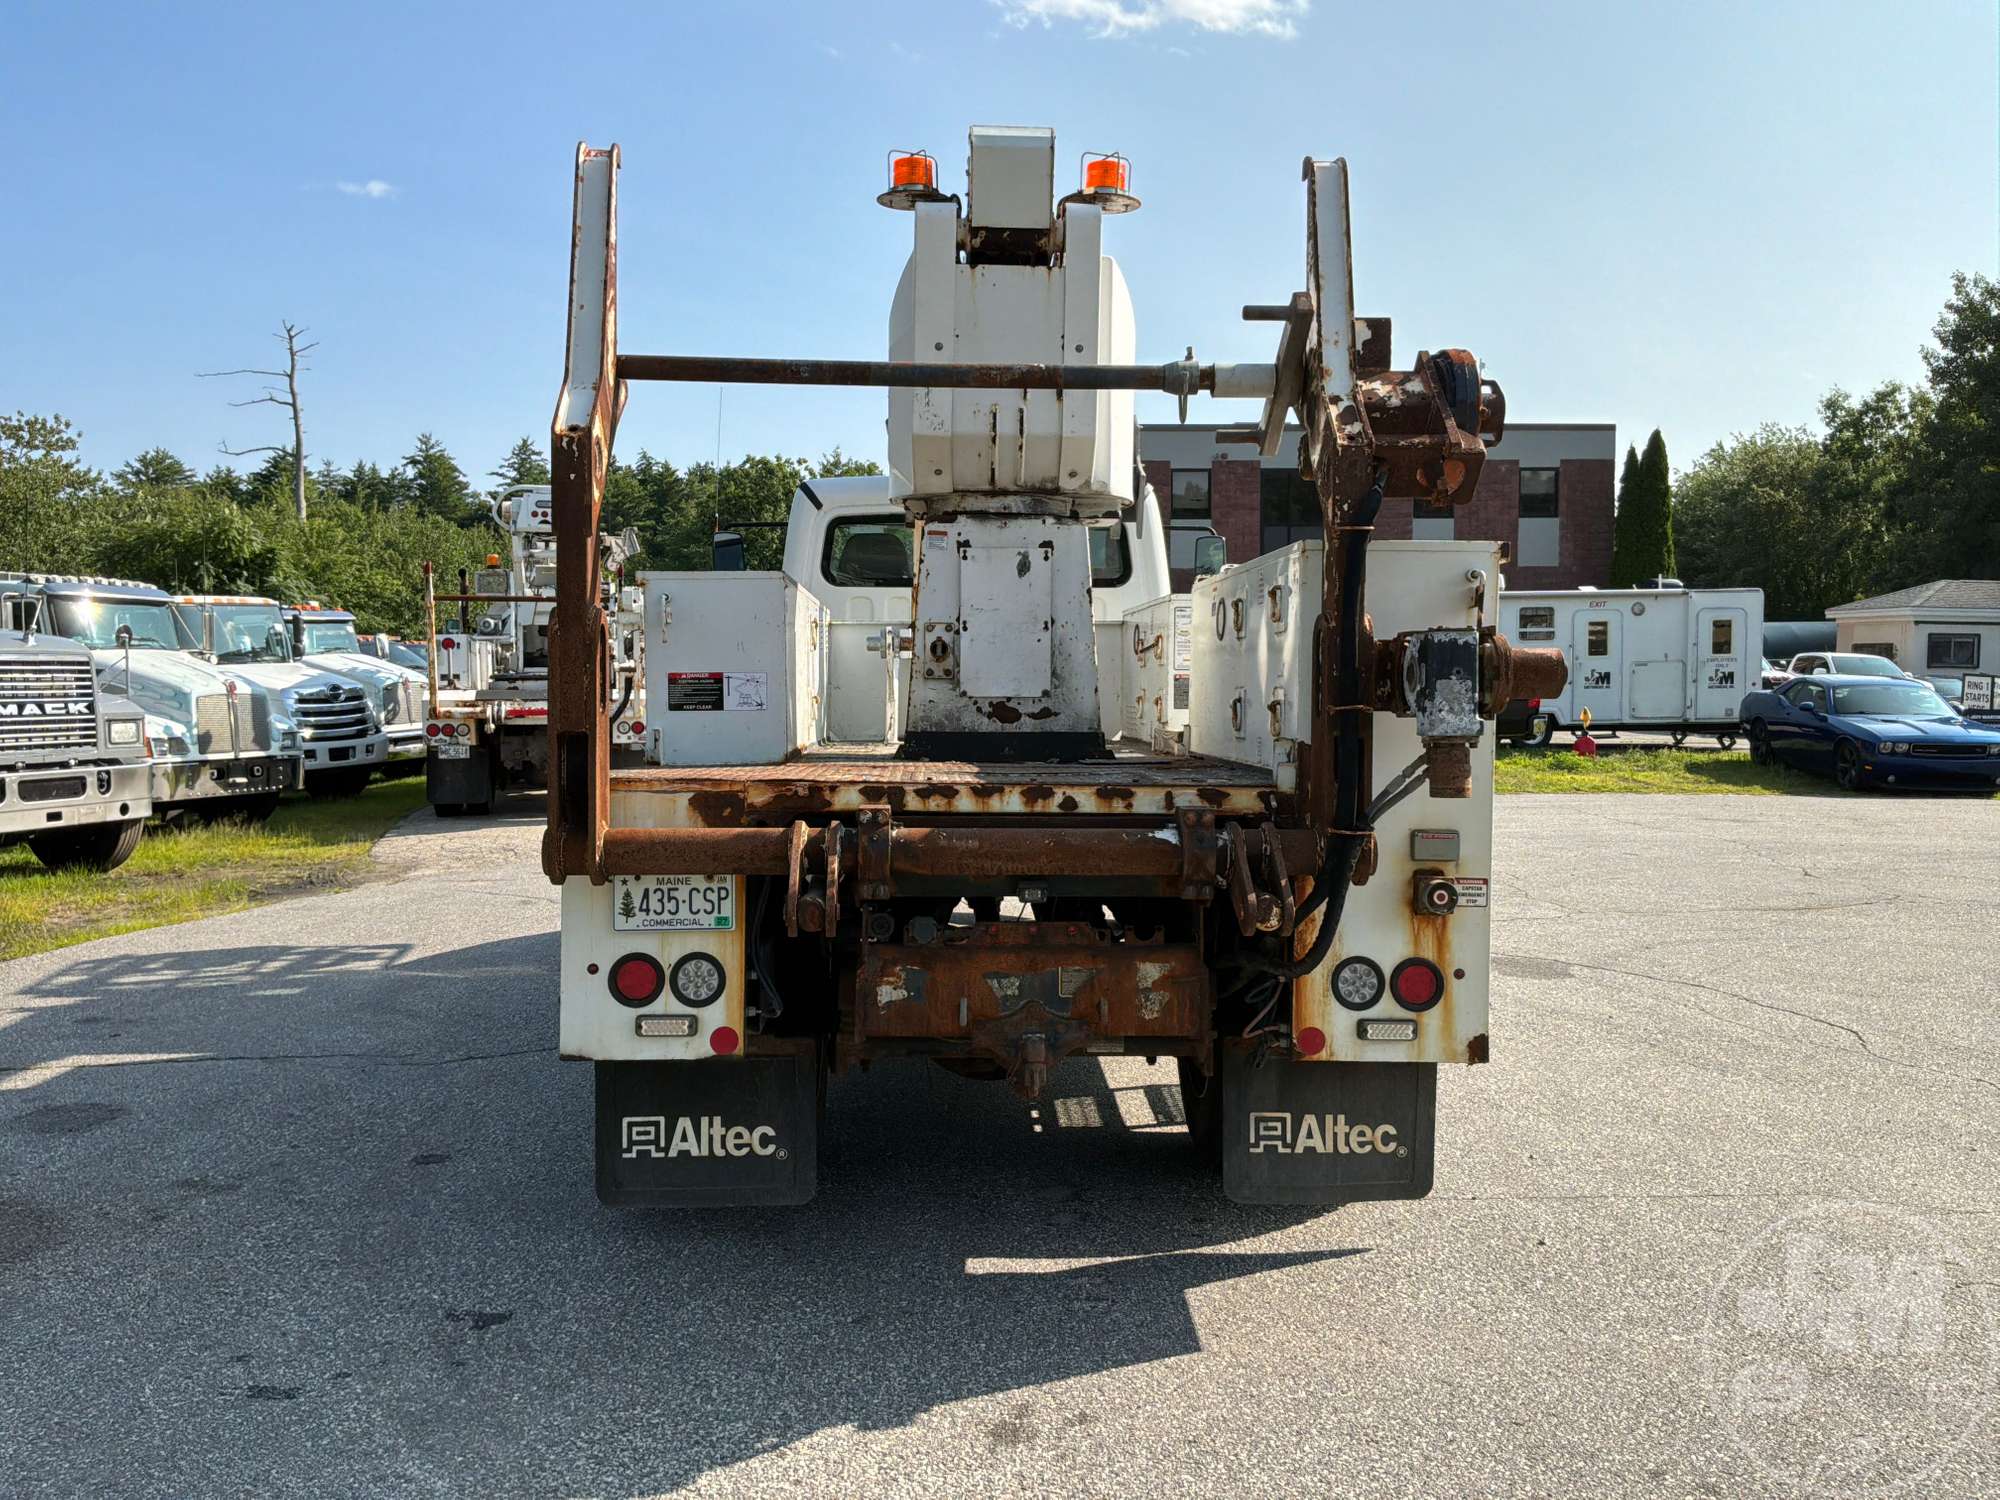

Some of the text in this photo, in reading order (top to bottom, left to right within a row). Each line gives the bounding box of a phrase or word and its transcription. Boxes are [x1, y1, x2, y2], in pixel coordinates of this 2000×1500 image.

[1967, 681, 1984, 690] RING
[1965, 692, 1989, 703] STARTS
[656, 877, 692, 886] MAINE
[642, 918, 704, 928] COMMERCIAL
